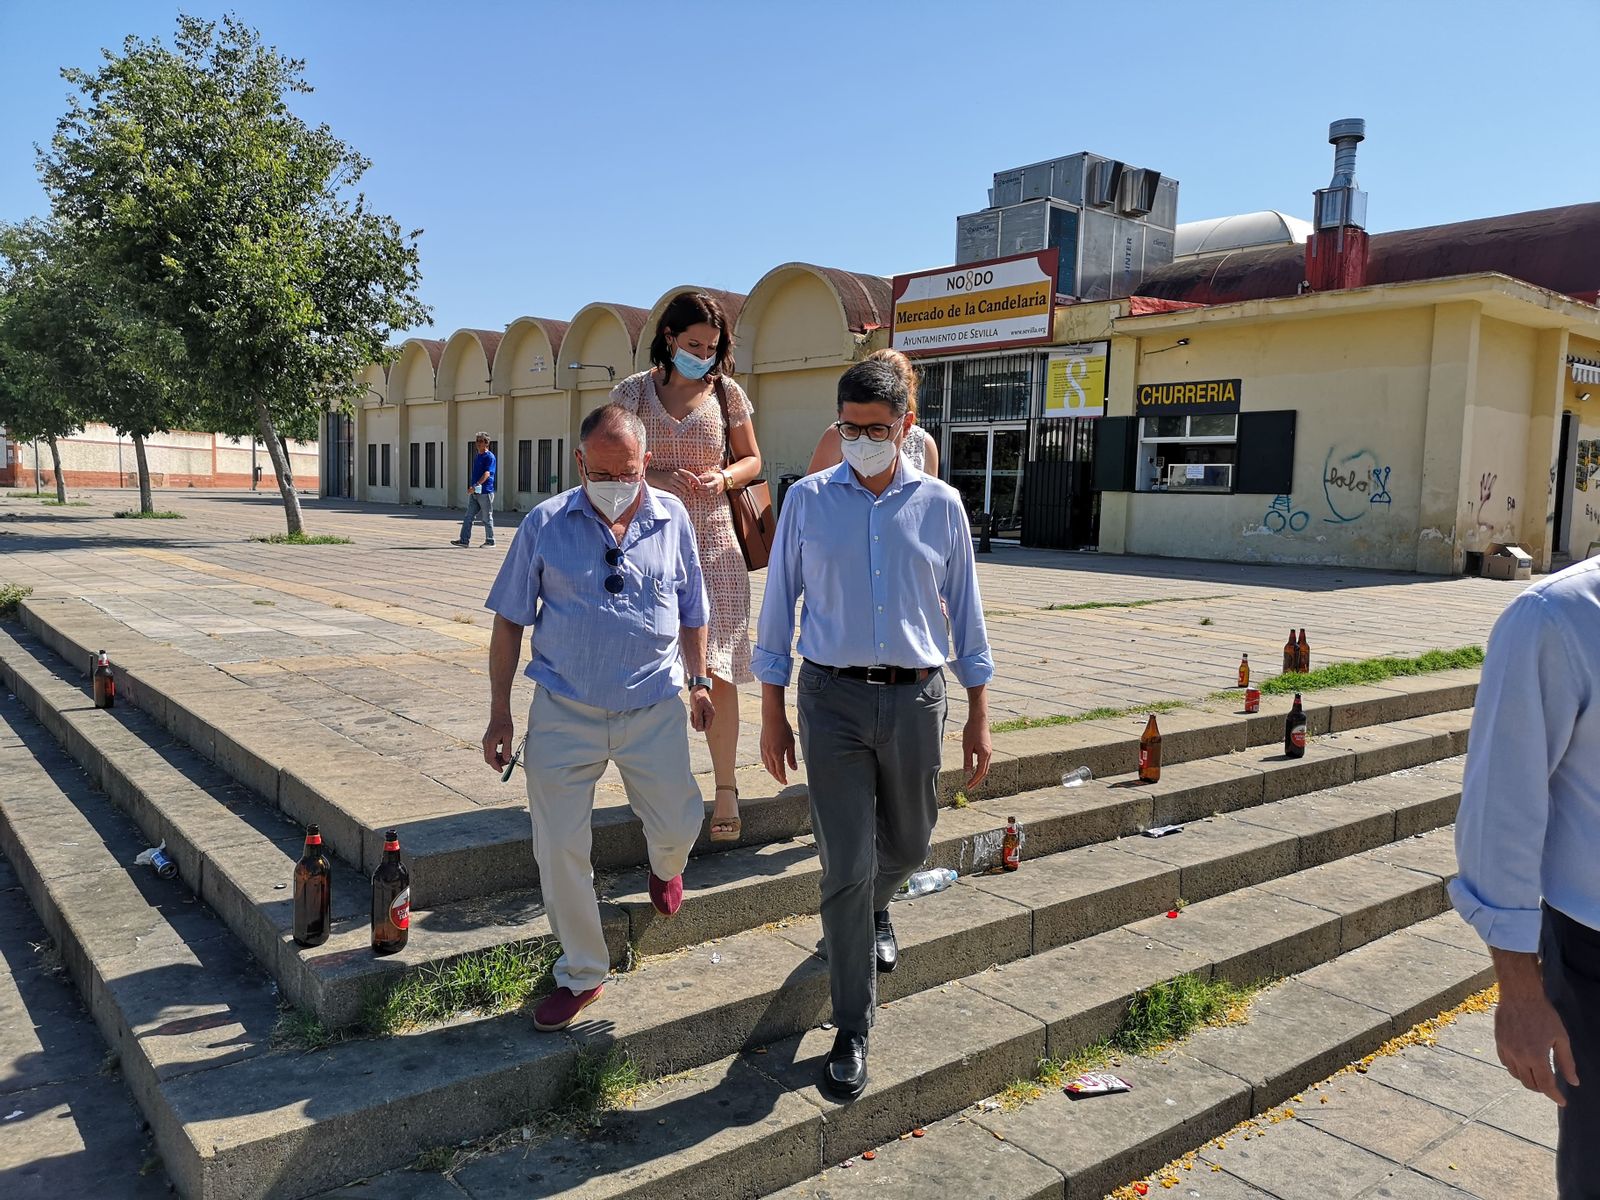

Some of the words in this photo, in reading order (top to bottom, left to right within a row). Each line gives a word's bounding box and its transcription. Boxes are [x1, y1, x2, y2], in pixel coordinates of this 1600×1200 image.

[896, 307, 944, 324] Mercado
[947, 304, 961, 318] de
[964, 302, 976, 316] la
[978, 291, 1047, 314] Candelaria
[902, 332, 957, 346] AYUNTAMIENTO
[958, 331, 969, 340] DE
[969, 328, 999, 339] SEVILLA
[1010, 327, 1047, 336] www.sevilla.org
[1140, 382, 1236, 406] CHURRERIA
